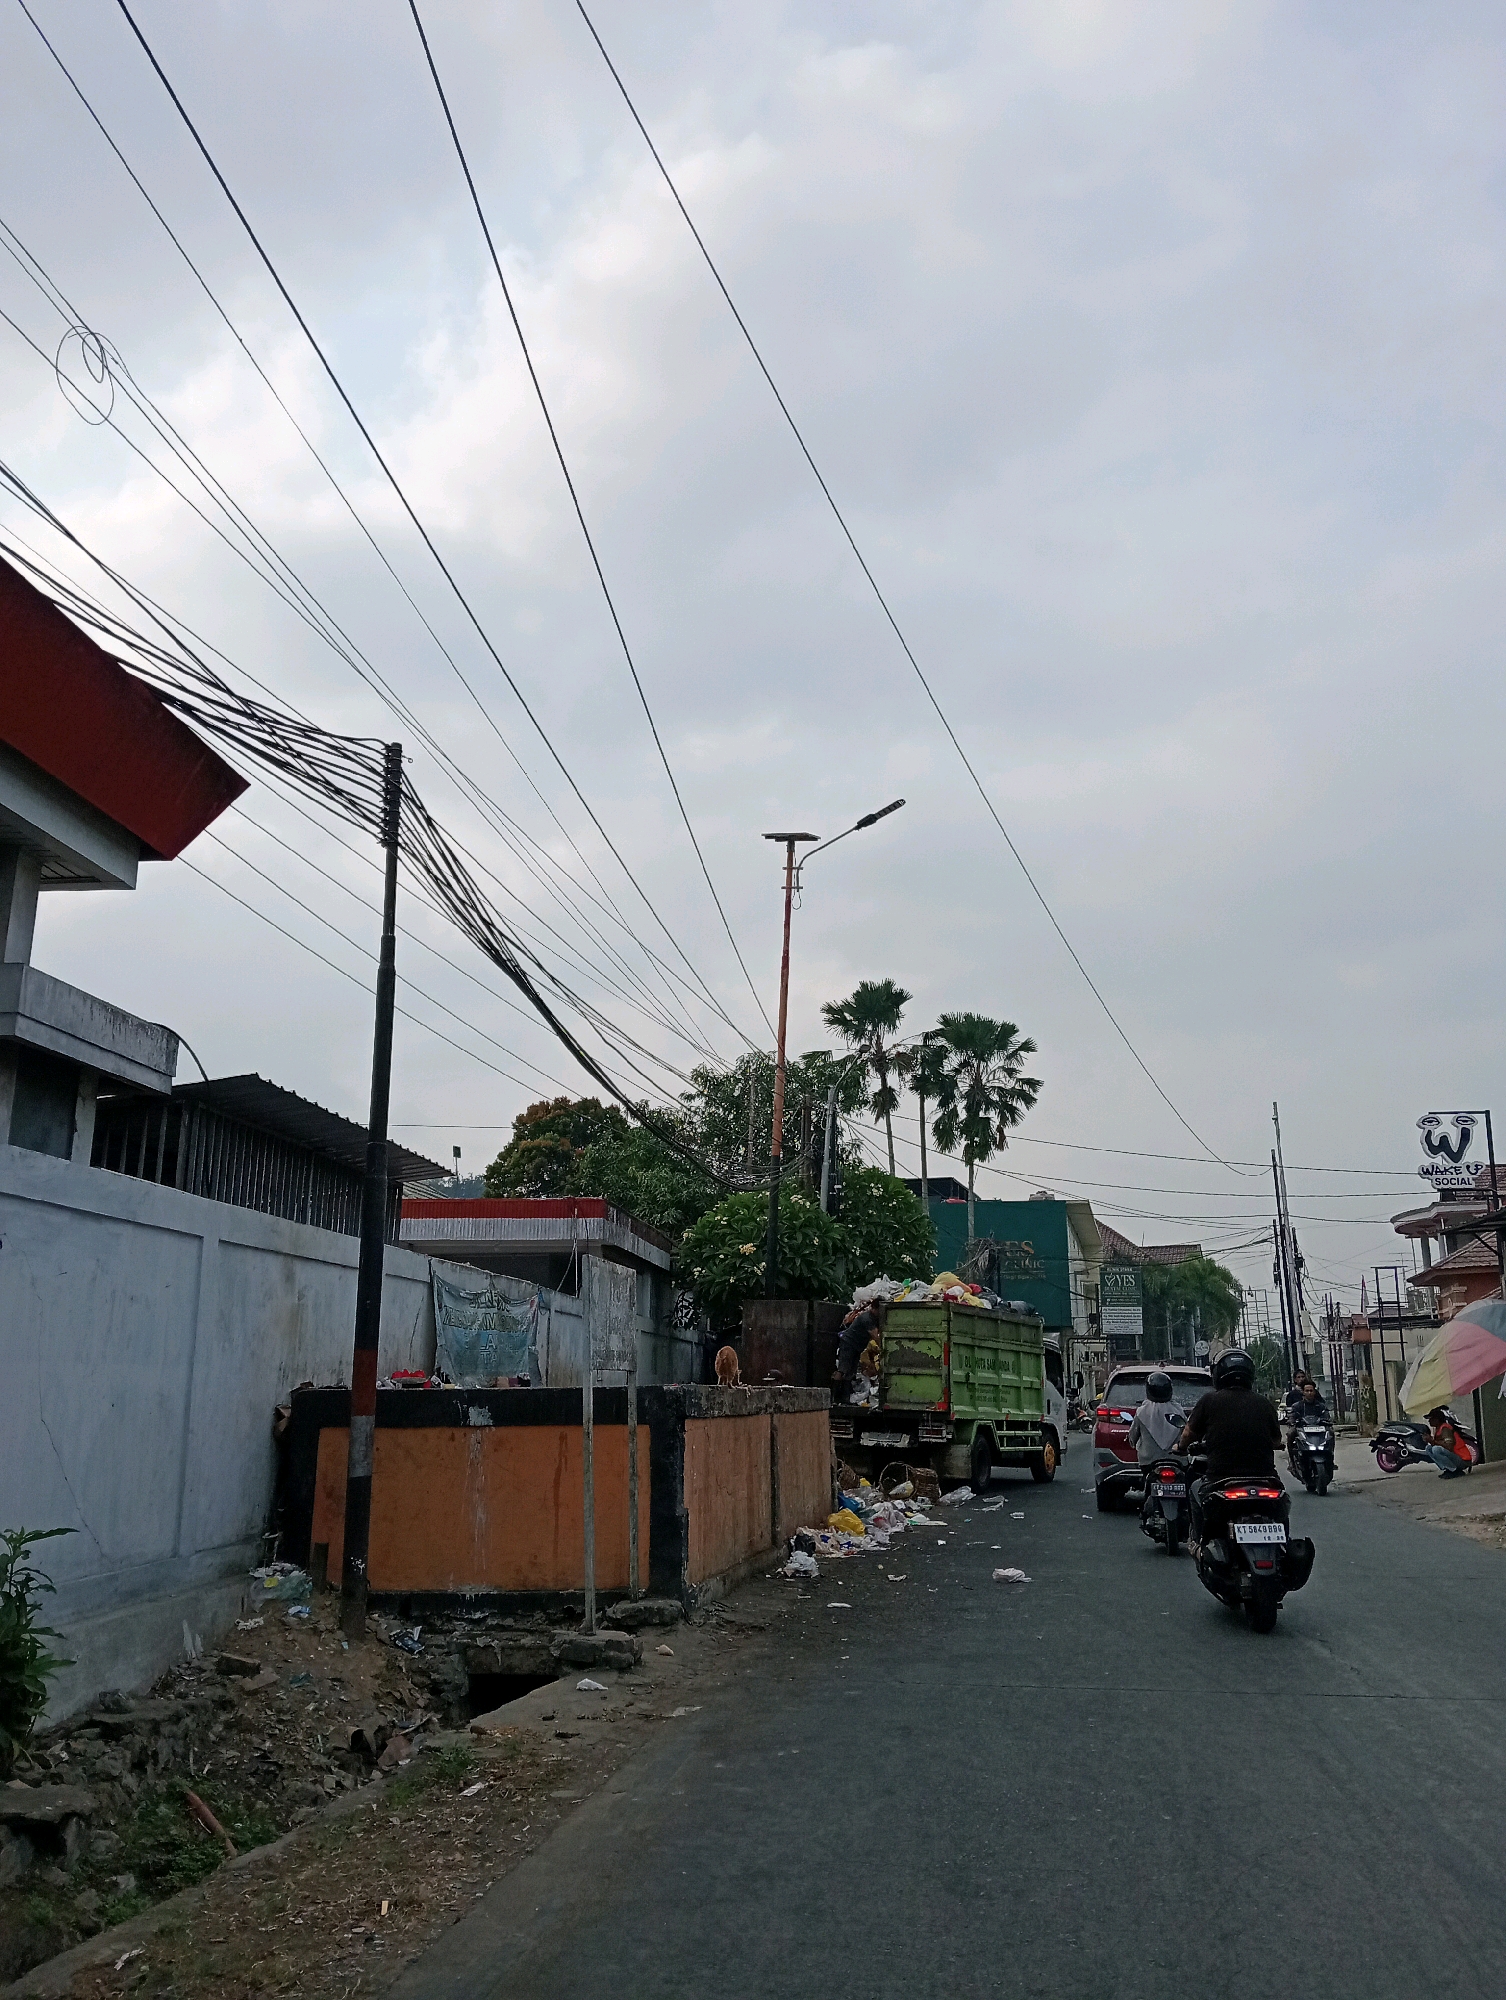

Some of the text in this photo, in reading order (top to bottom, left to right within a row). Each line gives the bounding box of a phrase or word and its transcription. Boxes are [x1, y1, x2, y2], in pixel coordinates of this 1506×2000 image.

[1421, 1163, 1484, 1176] WAKE UP
[1435, 1177, 1473, 1186] SOCIAL
[1116, 1274, 1135, 1287] YES
[1237, 1525, 1247, 1534] KT
